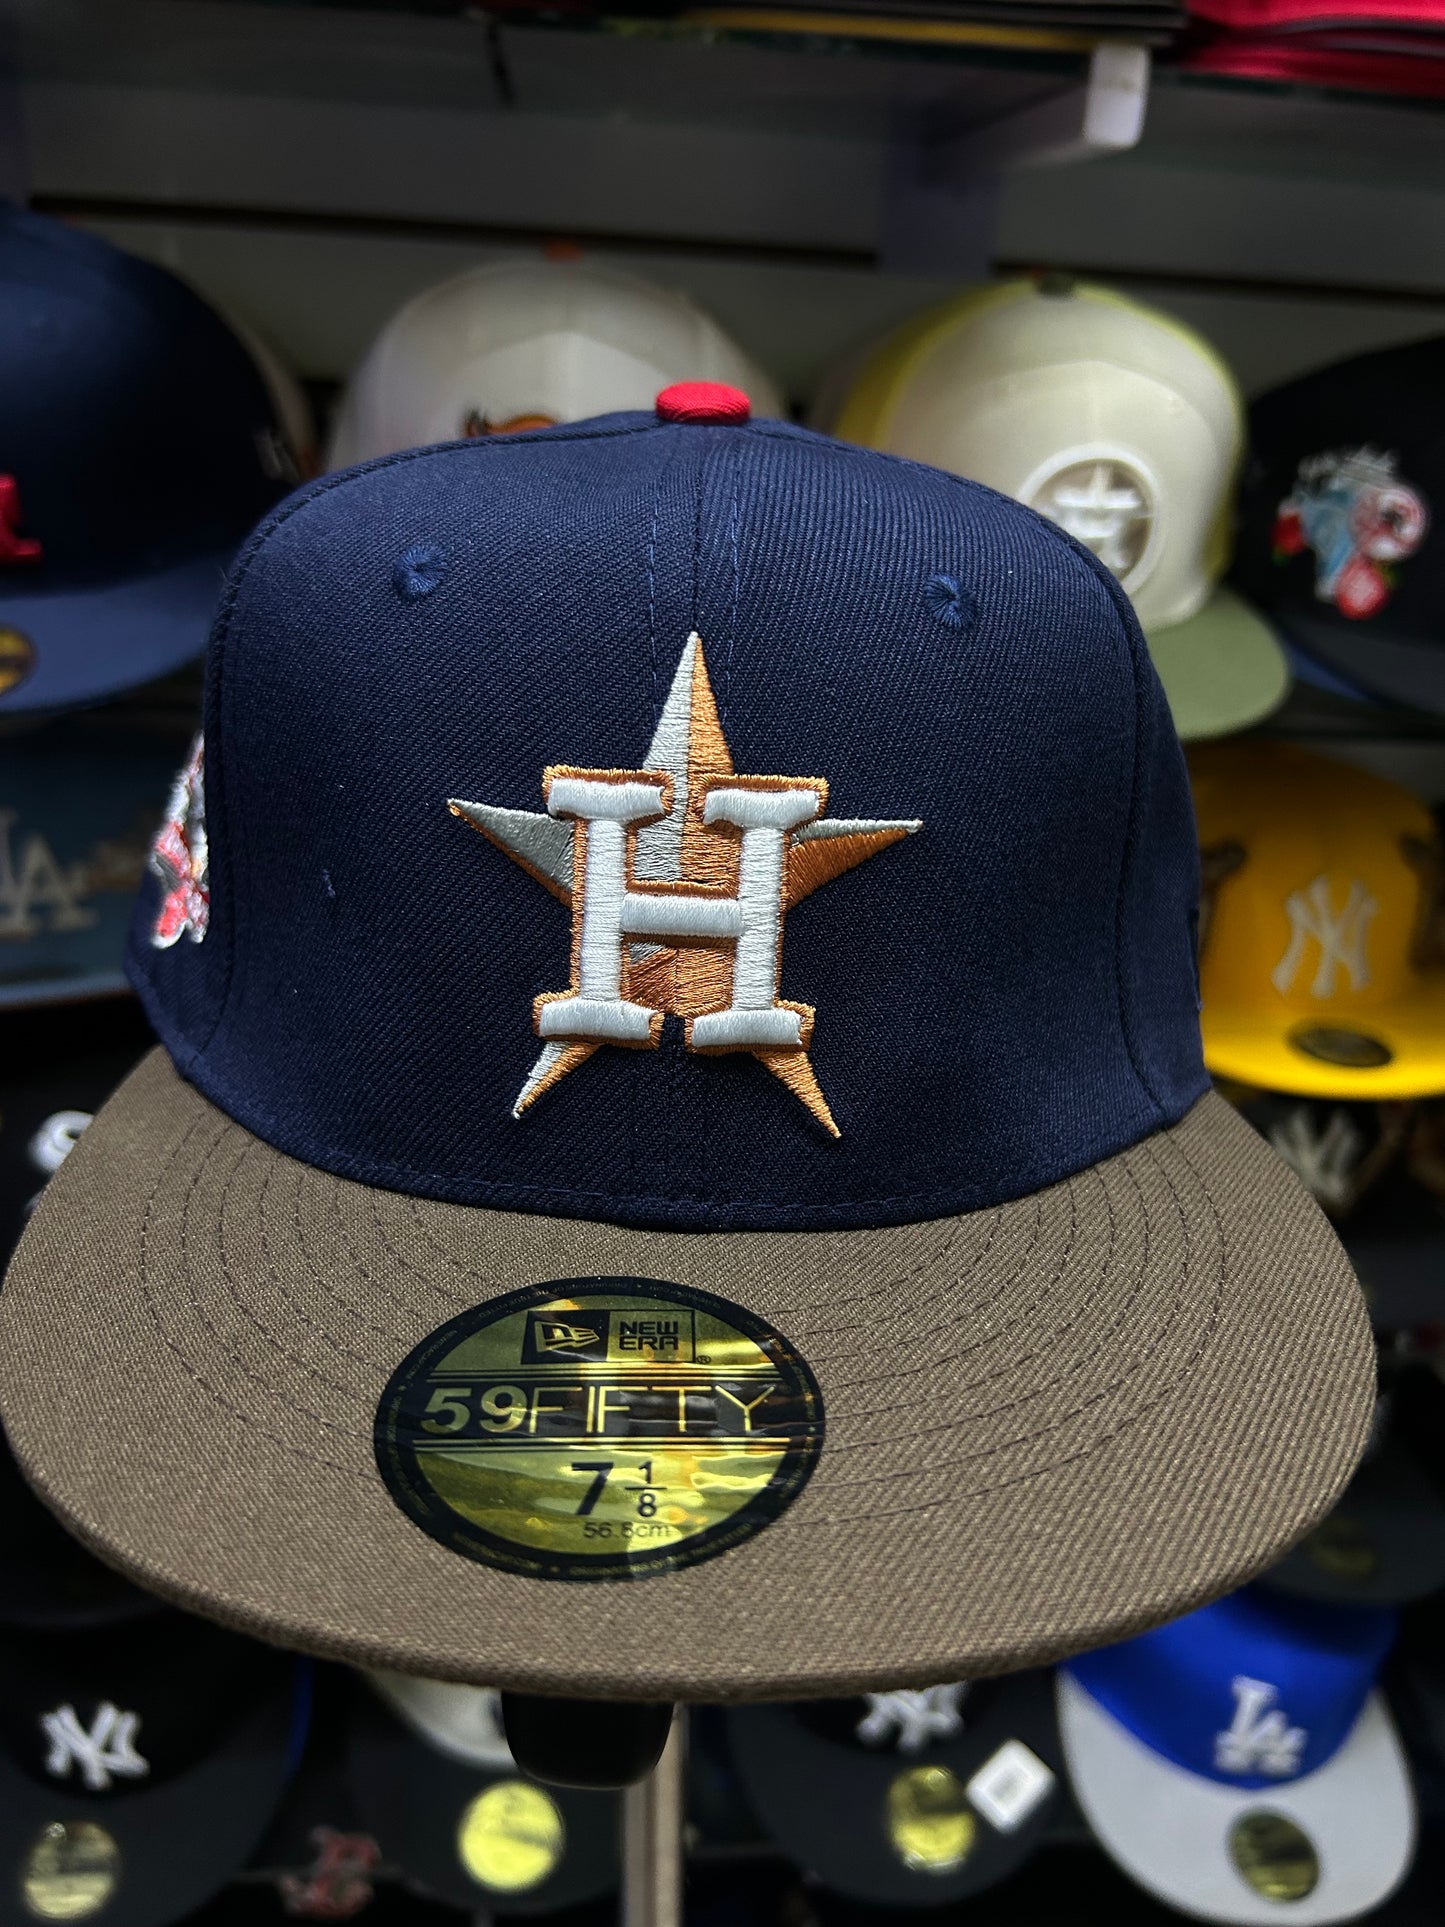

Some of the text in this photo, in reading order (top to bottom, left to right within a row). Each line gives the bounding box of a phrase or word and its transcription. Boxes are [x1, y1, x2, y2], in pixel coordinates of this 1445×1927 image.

[534, 766, 829, 1055] H
[1272, 874, 1377, 998] NY
[619, 1320, 679, 1335] NEW
[619, 1335, 679, 1351] ERA
[420, 1384, 776, 1434] 59FIFTY
[571, 1461, 614, 1516] 7
[43, 1702, 148, 1789] NY
